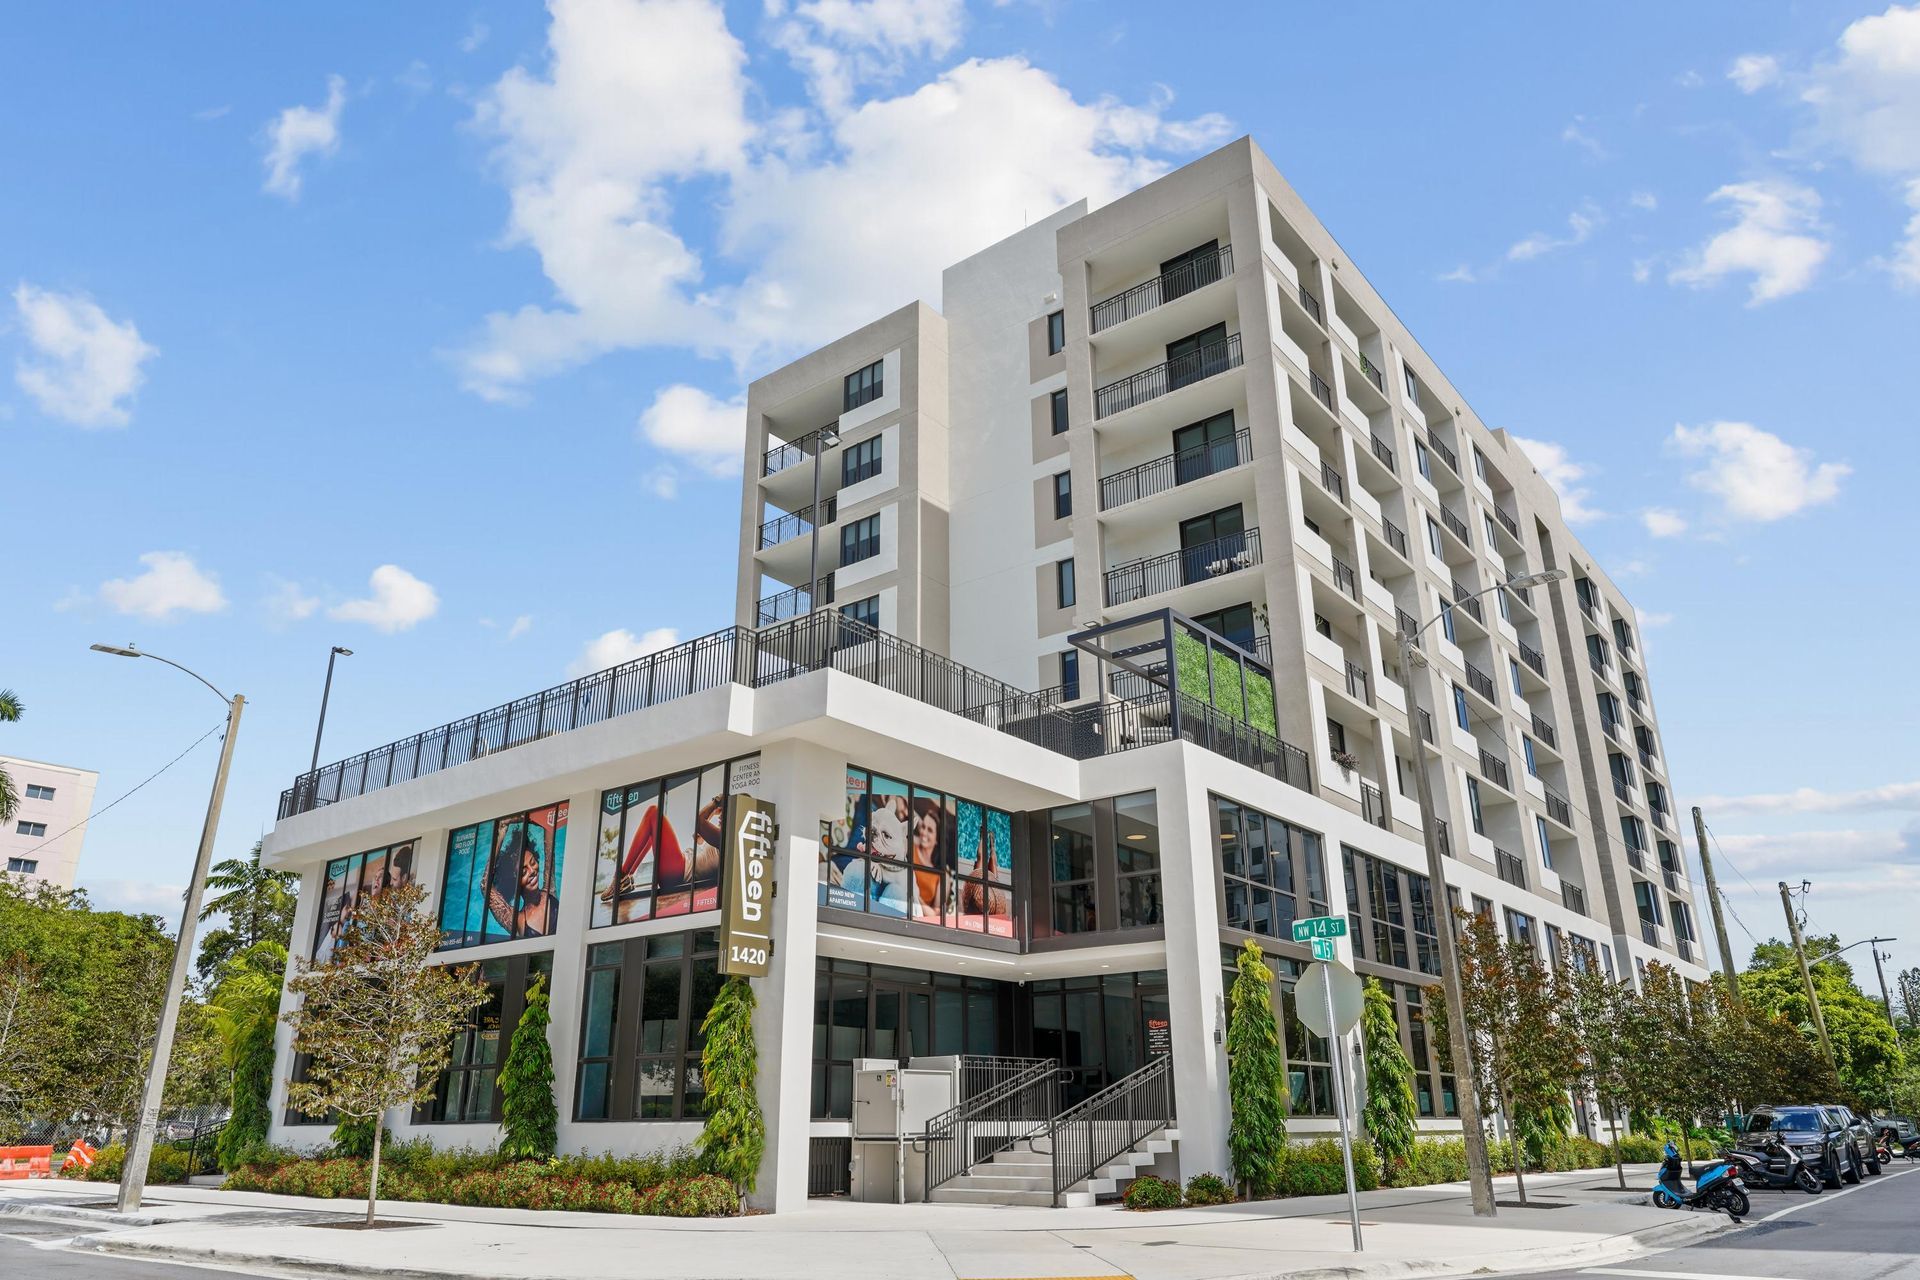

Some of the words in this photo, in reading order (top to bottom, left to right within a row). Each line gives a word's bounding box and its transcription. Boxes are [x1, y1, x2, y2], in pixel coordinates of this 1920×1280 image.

[739, 762, 760, 772] FITNESS
[732, 772, 752, 782] CENTER
[731, 781, 747, 790] YOGA
[748, 778, 760, 786] ROO
[739, 811, 773, 922] fifteen
[829, 897, 857, 907] APARTMENTS
[1298, 926, 1309, 937] NW
[1313, 920, 1327, 936] 14
[1330, 922, 1340, 933] ST
[731, 945, 766, 965] 1420
